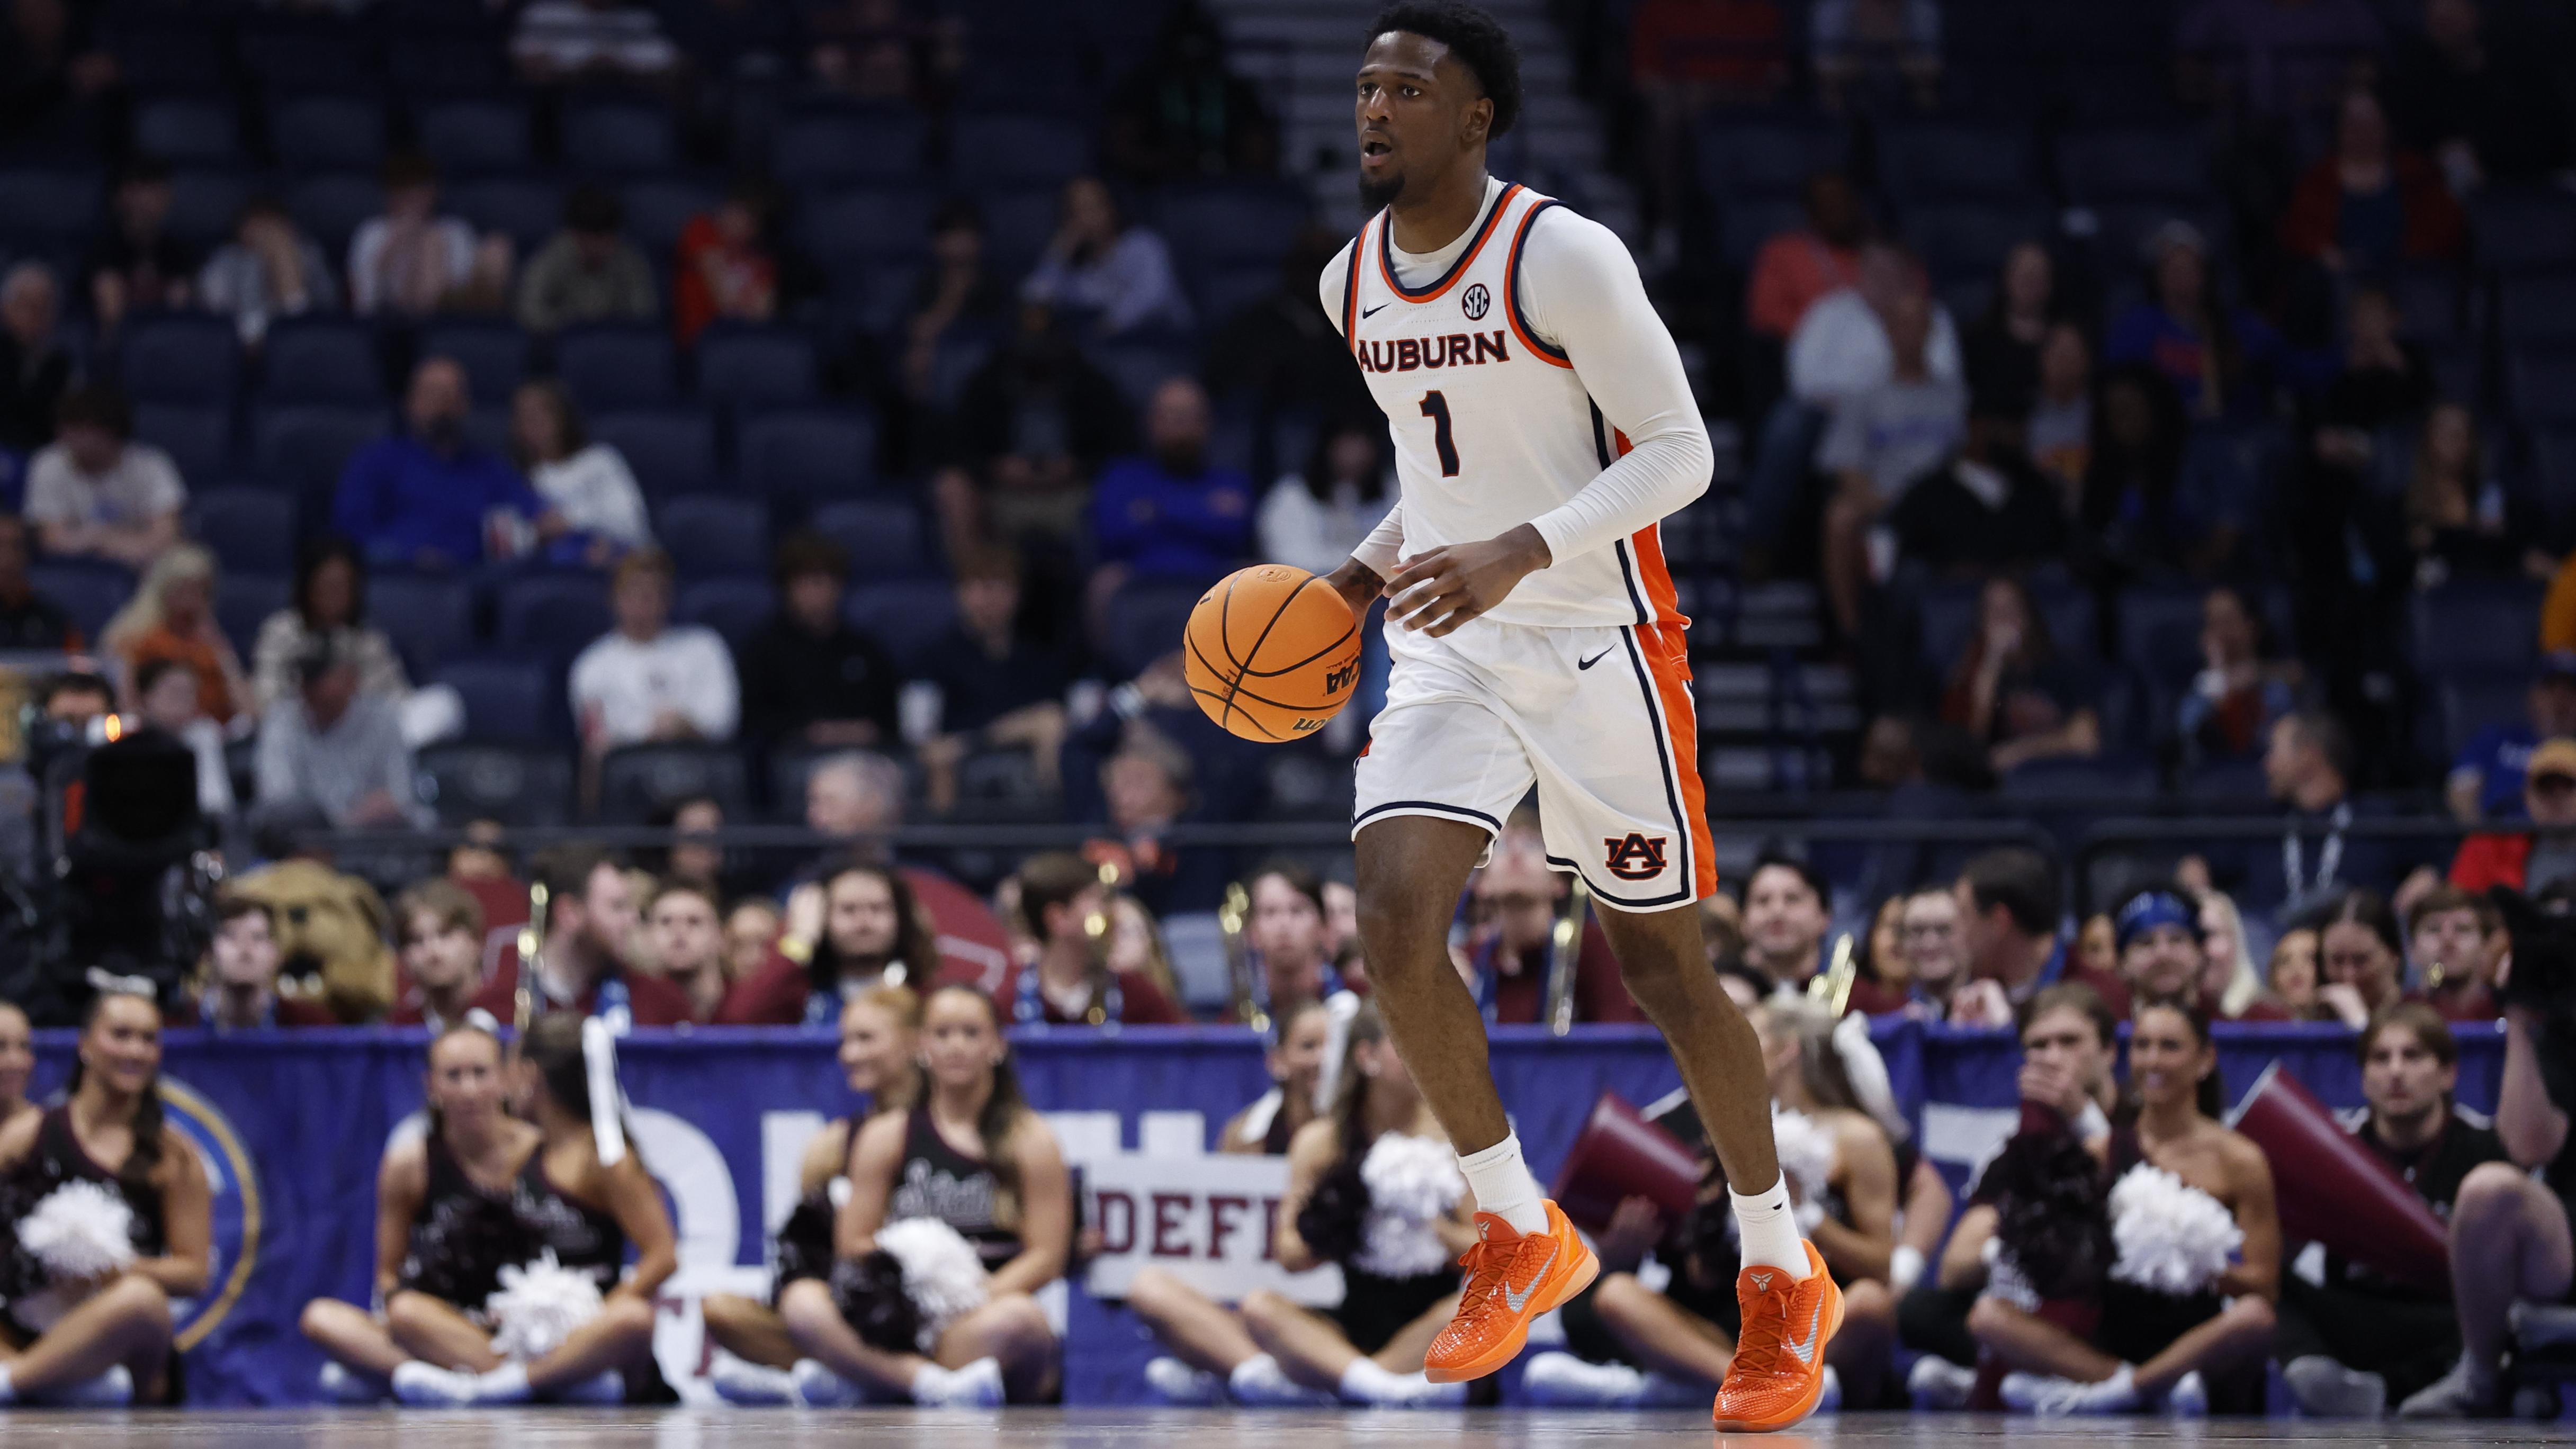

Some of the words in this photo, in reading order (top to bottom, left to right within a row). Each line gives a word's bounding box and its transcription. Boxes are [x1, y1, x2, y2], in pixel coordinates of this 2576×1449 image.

[1464, 286, 1488, 318] SEC
[1359, 330, 1510, 373] AUBURN
[1419, 390, 1460, 478] 1
